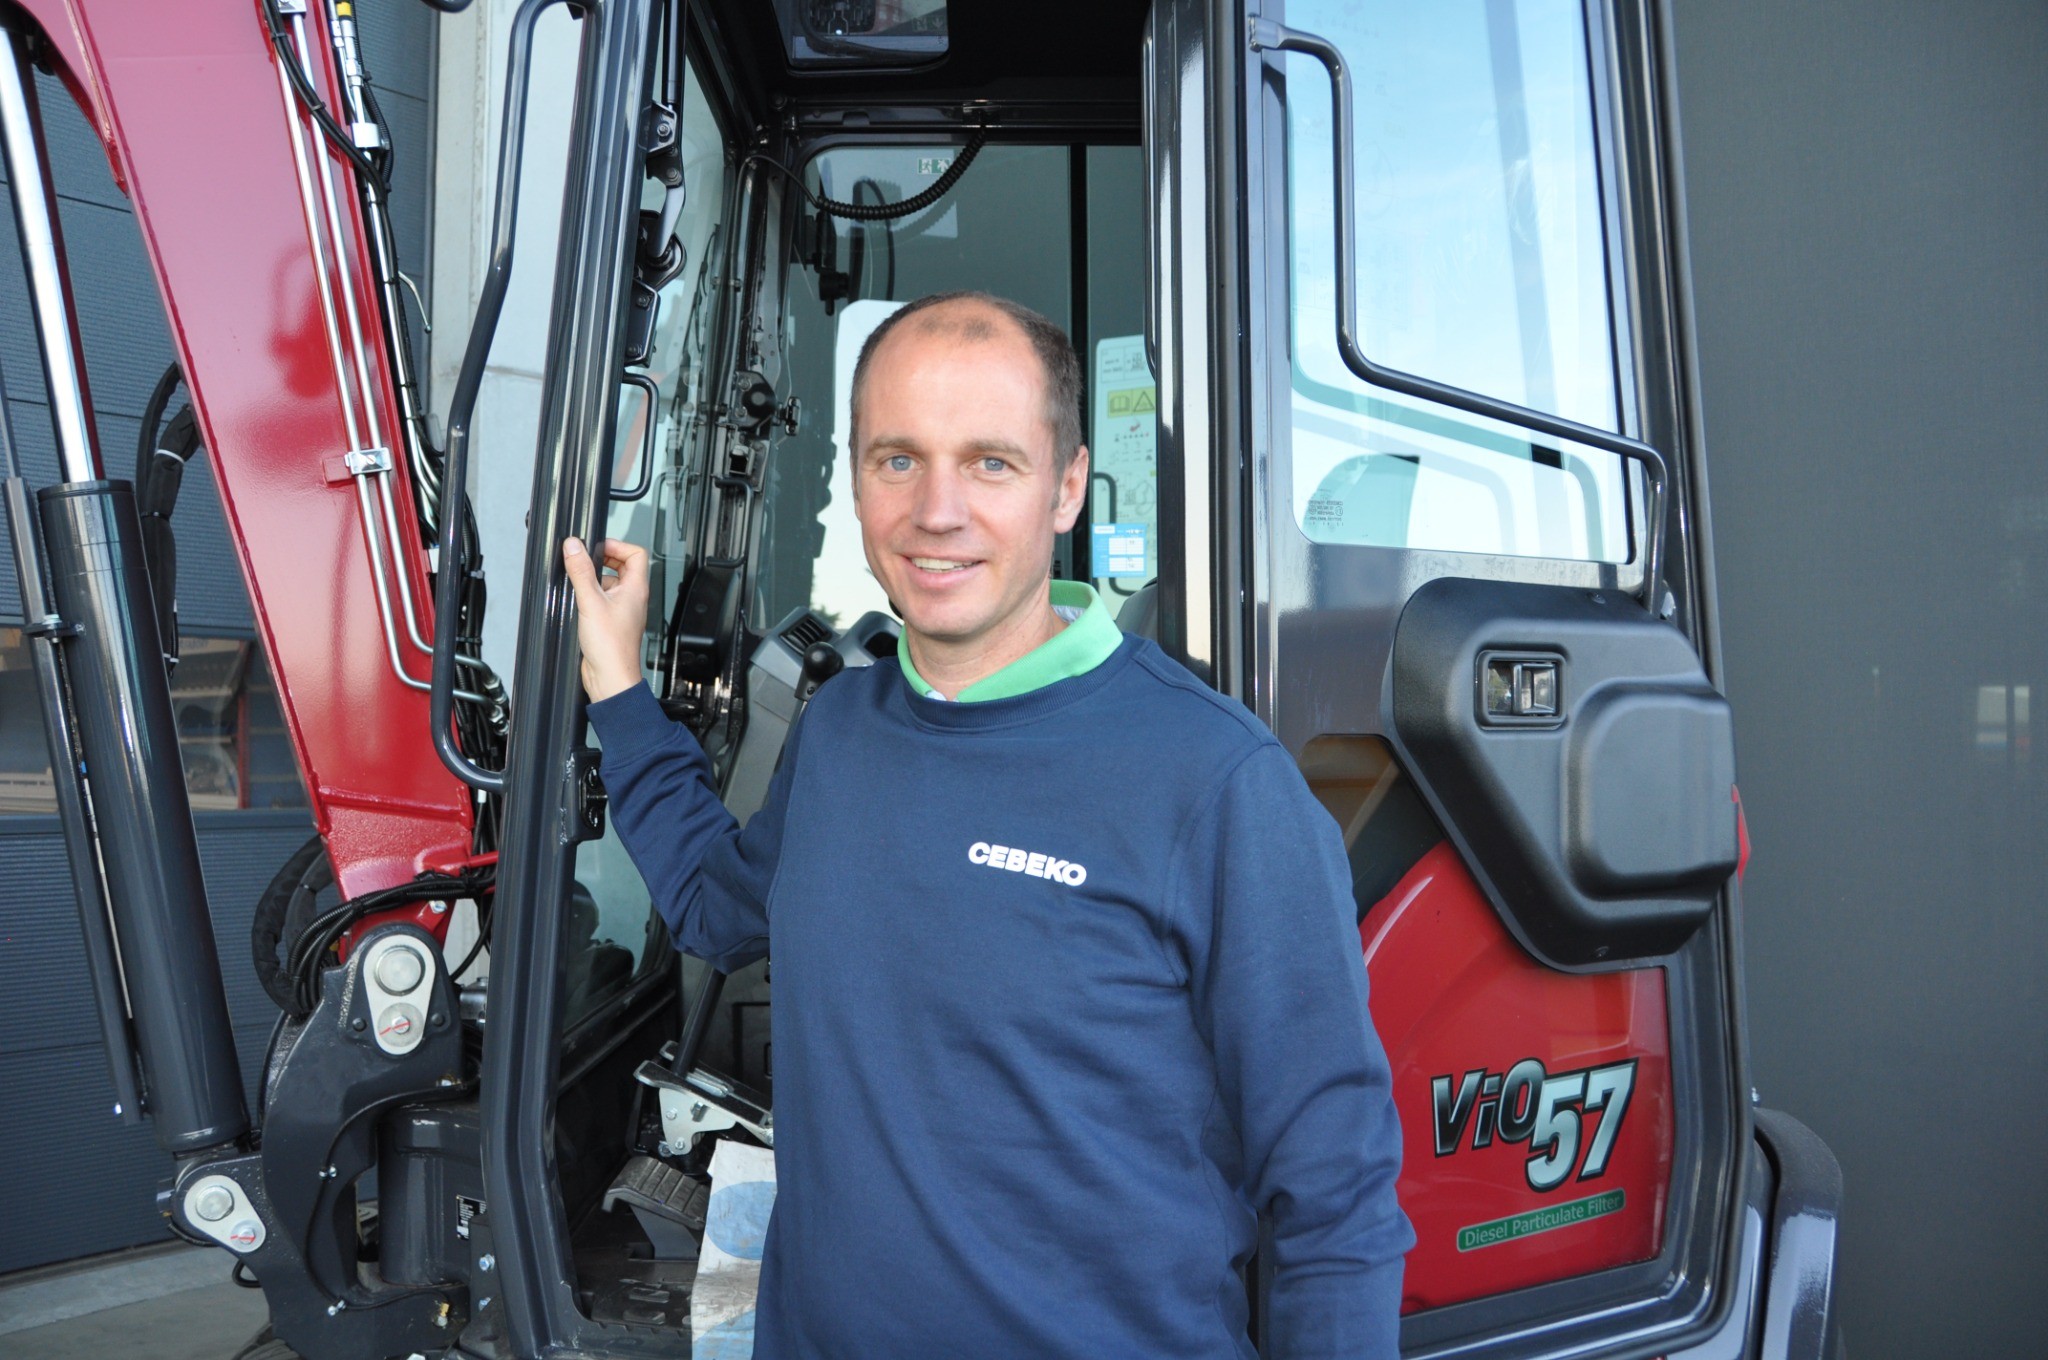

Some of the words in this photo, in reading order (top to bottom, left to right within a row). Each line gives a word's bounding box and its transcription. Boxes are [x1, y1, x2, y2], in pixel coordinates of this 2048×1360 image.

[967, 841, 1087, 887] CEBEKO
[1465, 1224, 1508, 1247] Diesel
[1512, 1204, 1584, 1235] Particulate
[1588, 1196, 1620, 1215] Filter
